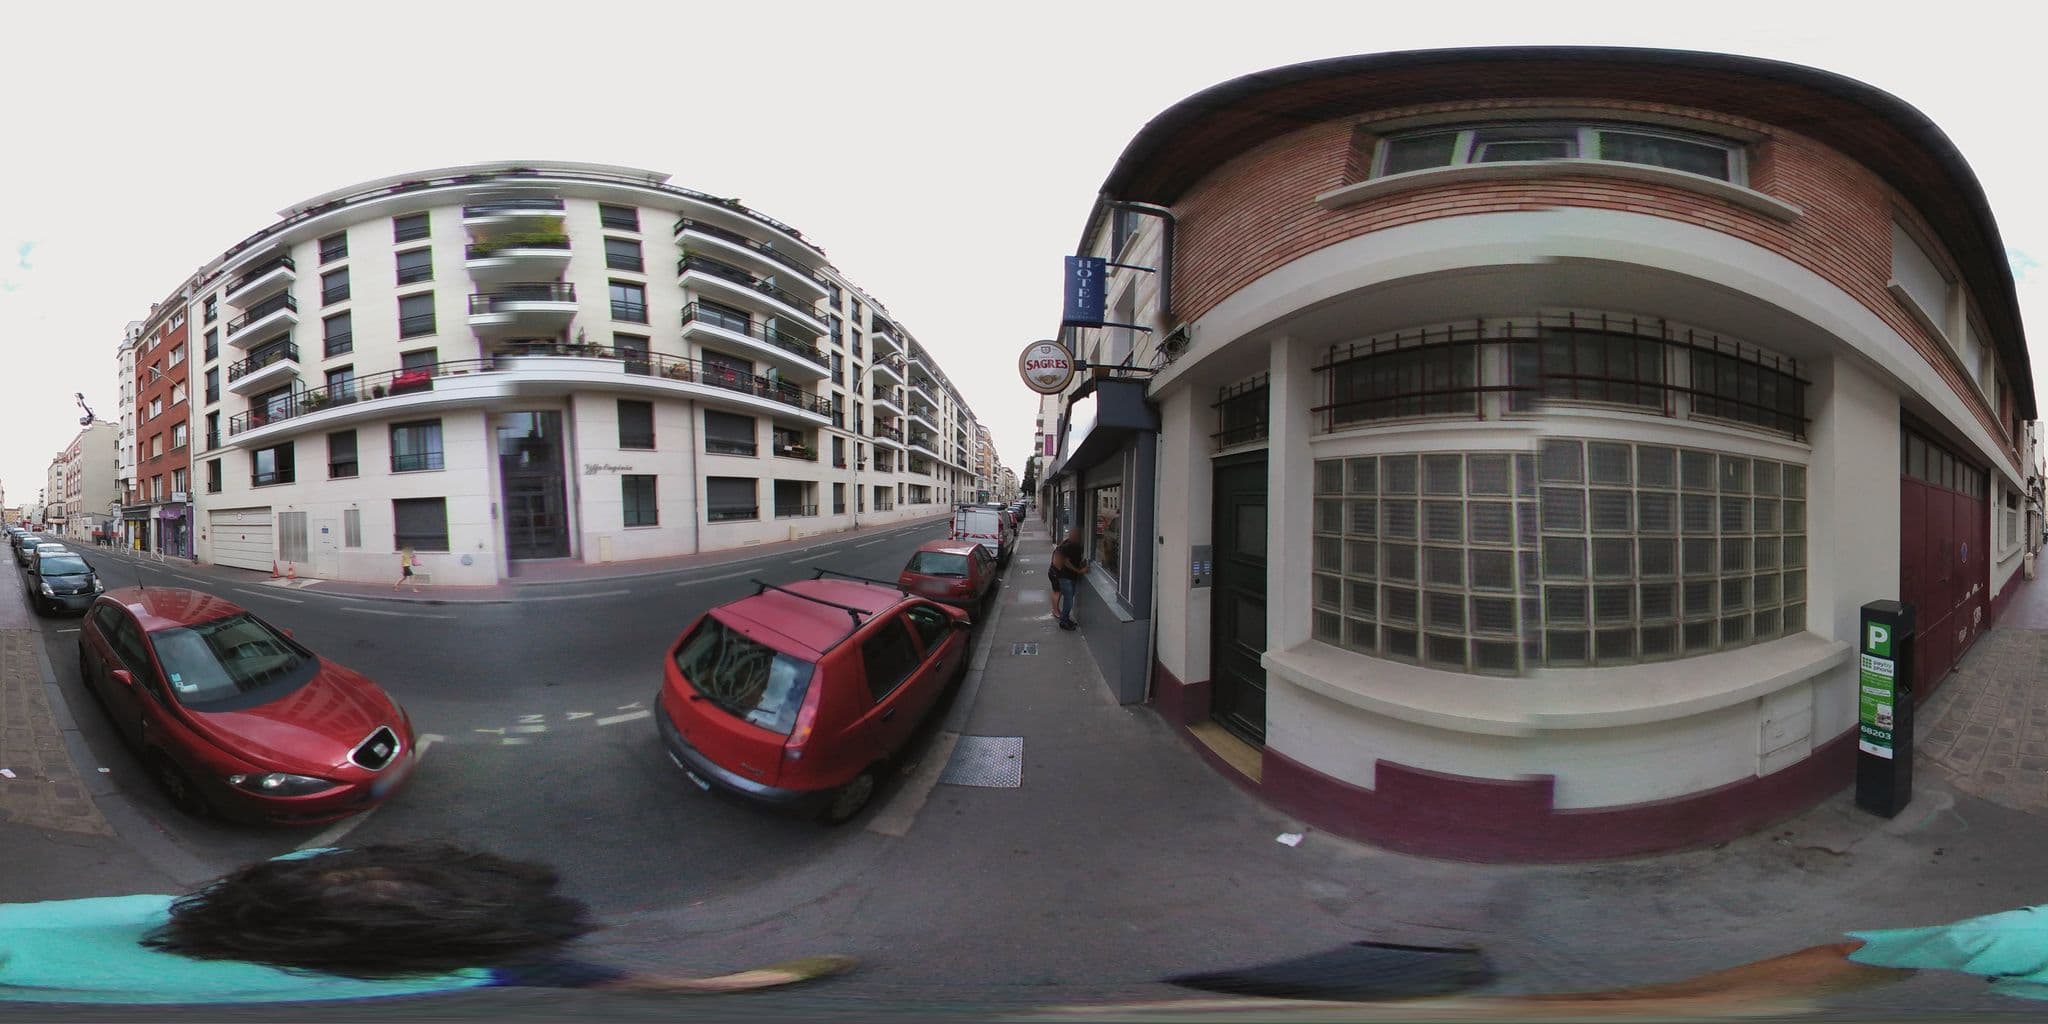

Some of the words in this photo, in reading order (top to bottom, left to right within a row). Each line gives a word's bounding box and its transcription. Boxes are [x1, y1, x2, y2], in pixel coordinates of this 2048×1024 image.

[1077, 260, 1092, 308] HOTEL
[1026, 359, 1068, 371] SAGRES
[1869, 625, 1888, 650] P
